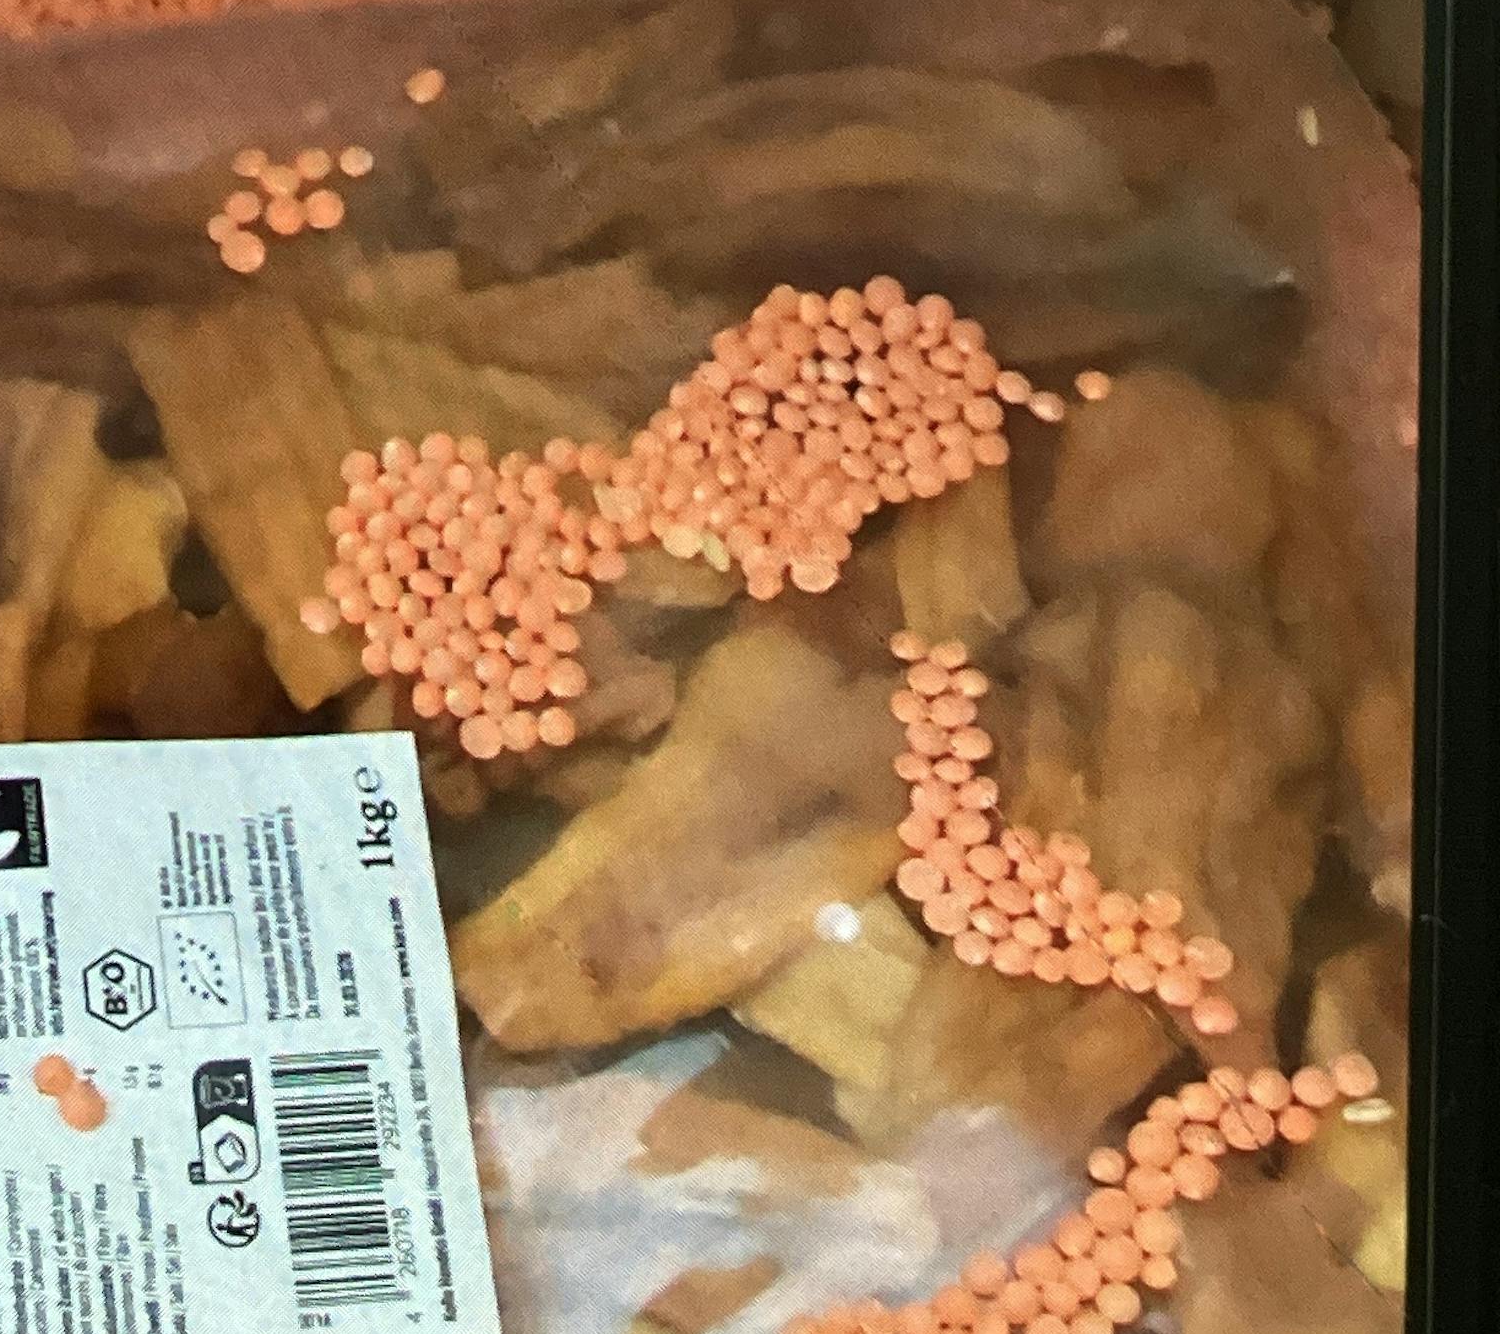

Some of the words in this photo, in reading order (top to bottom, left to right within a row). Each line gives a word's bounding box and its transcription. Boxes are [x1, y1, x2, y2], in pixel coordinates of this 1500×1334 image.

[21, 782, 42, 862] FAIRTRADE
[378, 1080, 401, 1150] 292234
[391, 1205, 418, 1277] 260718
